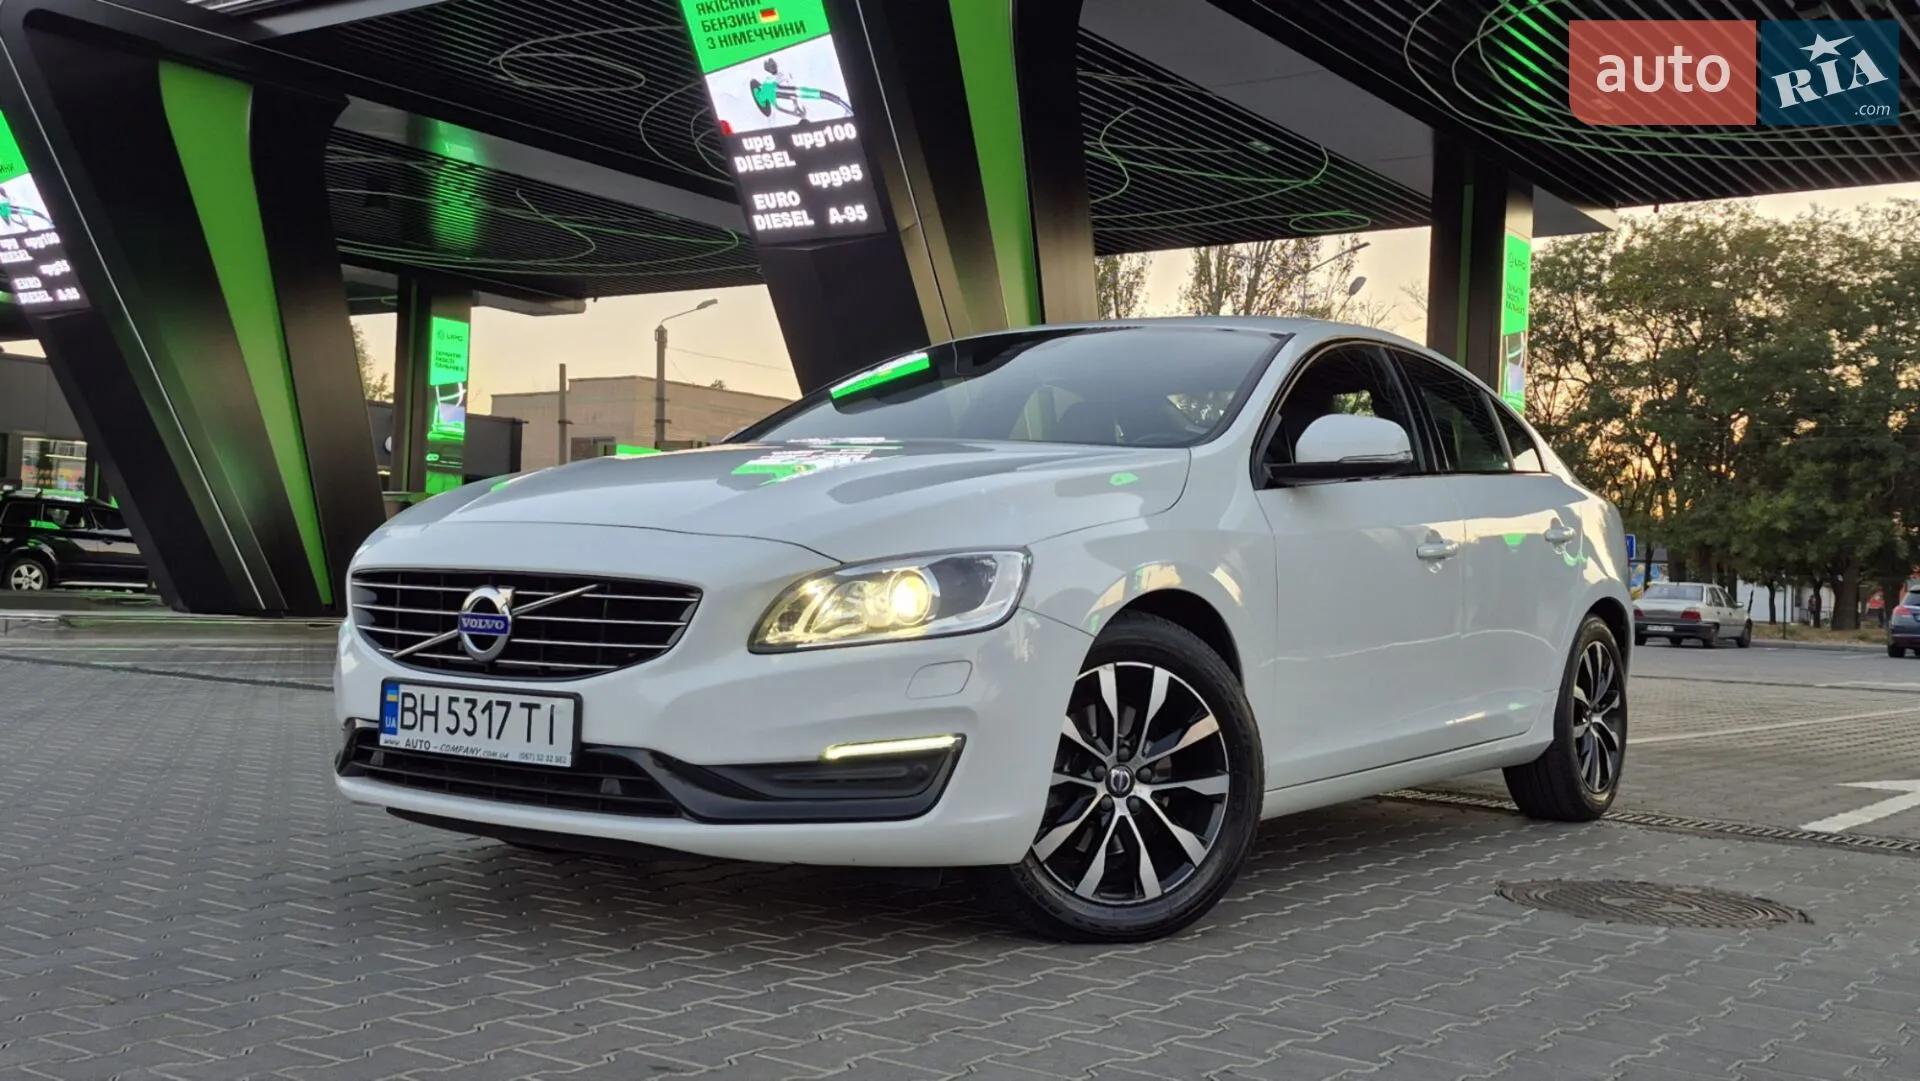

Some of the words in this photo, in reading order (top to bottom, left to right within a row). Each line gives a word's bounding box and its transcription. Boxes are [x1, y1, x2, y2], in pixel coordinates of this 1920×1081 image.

[701, 11, 758, 33] БЕНЗИН
[706, 37, 716, 49] З
[718, 20, 807, 48] НІМЕЧЧИНИ
[742, 134, 775, 152] upg
[792, 123, 857, 149] upg100
[734, 151, 796, 173] DIESEL
[808, 164, 863, 188] upg95
[753, 191, 801, 211] EURO
[753, 210, 815, 231] DIESEL
[461, 617, 505, 630] VOLVO
[385, 715, 397, 728] UA
[400, 692, 439, 733] BH
[446, 696, 512, 740] 5317
[405, 738, 431, 750] AUTO
